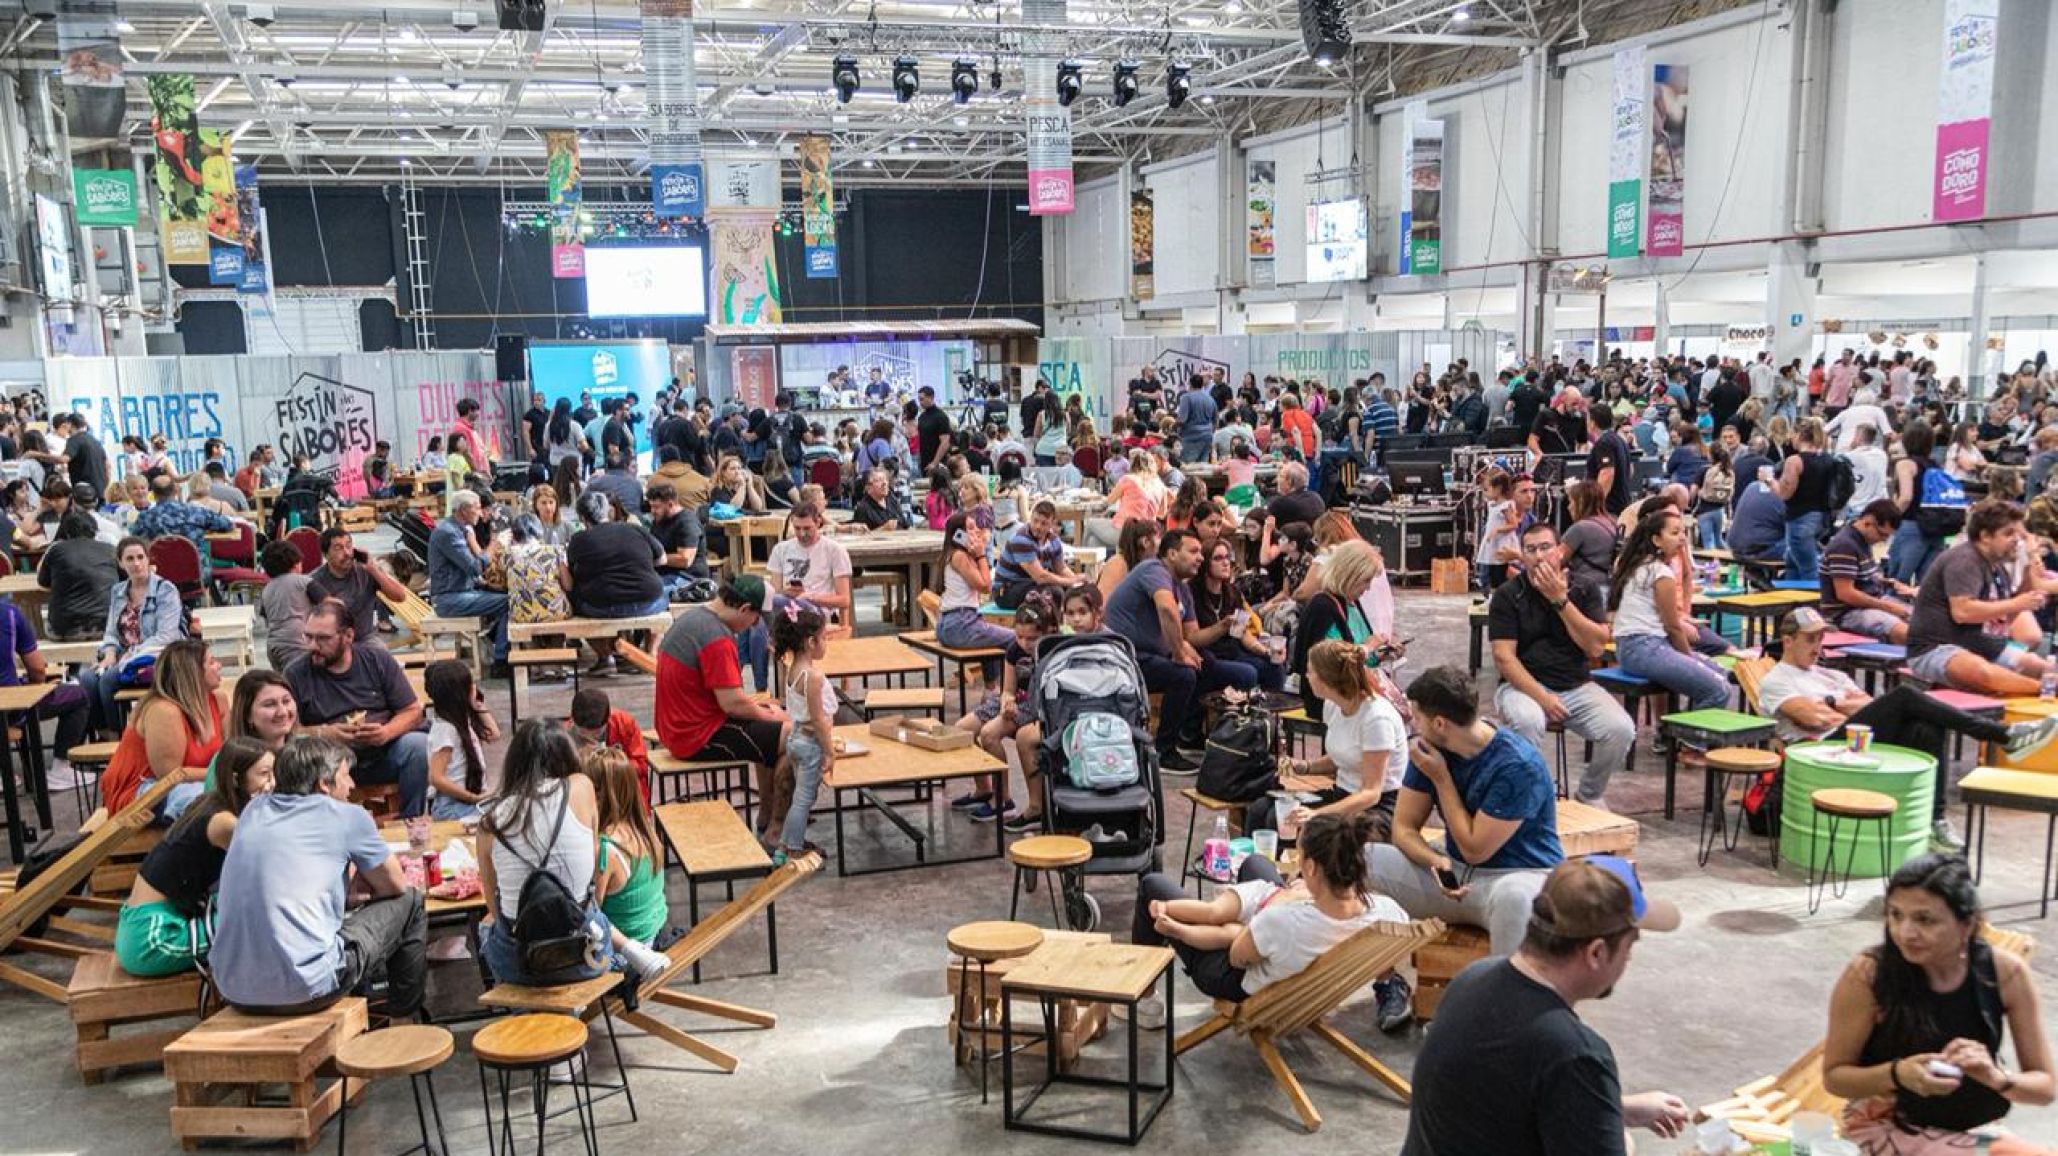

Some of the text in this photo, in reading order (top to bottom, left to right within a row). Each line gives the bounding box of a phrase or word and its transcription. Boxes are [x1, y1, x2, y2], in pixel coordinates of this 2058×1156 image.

[1030, 116, 1070, 132] PESCA
[1943, 152, 1979, 175] COMO
[1941, 170, 1977, 192] DORO
[1278, 348, 1370, 370] PRODUCTOS
[280, 417, 371, 468] SABORES
